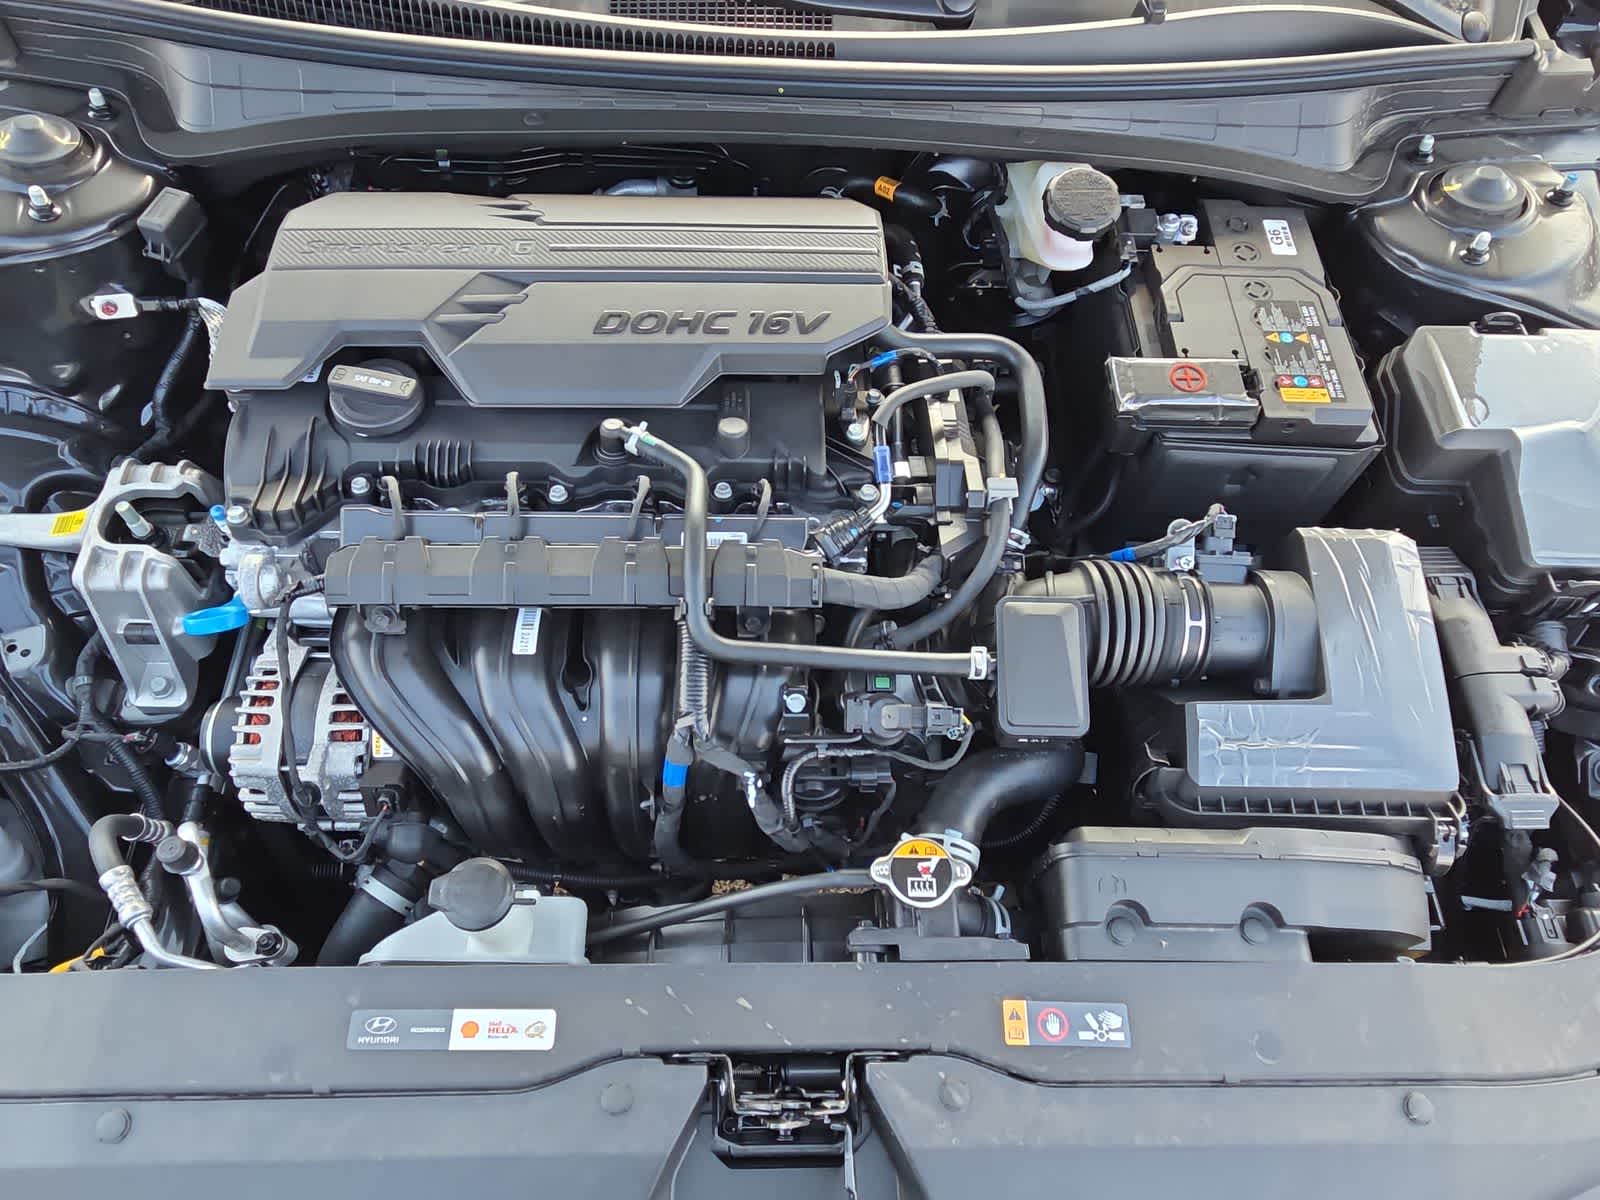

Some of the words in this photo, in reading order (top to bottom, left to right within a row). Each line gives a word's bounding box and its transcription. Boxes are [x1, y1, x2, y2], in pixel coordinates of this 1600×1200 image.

[1268, 229, 1284, 246] G6
[510, 238, 537, 256] G
[593, 309, 739, 336] DOHC
[747, 309, 832, 336] 16V
[357, 1036, 400, 1045] HYUNDAI
